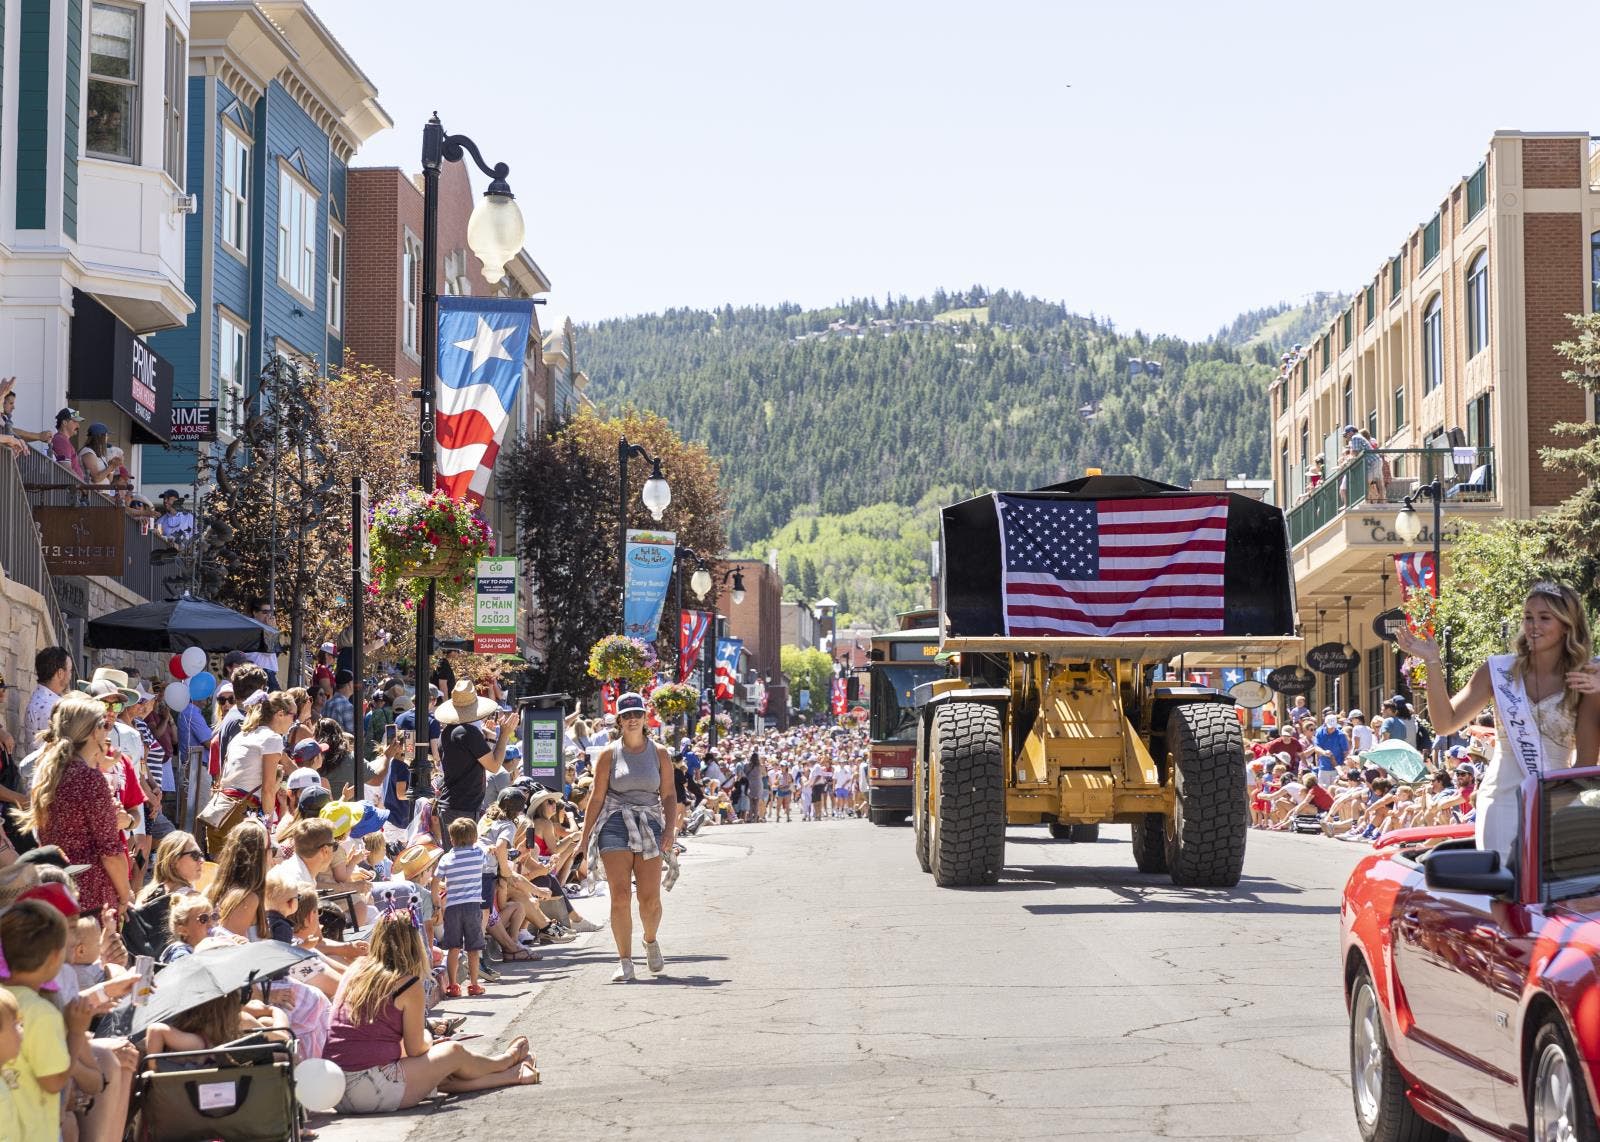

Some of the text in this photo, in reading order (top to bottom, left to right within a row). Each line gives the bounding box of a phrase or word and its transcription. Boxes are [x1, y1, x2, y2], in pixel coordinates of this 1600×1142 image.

[132, 339, 157, 392] PRIME
[171, 408, 210, 425] RIME
[180, 425, 208, 433] HOUSE
[1362, 517, 1380, 526] The
[489, 563, 503, 572] GO
[480, 600, 513, 610] PCMAIN
[481, 614, 510, 624] 25023
[1510, 720, 1530, 738] 2nd
